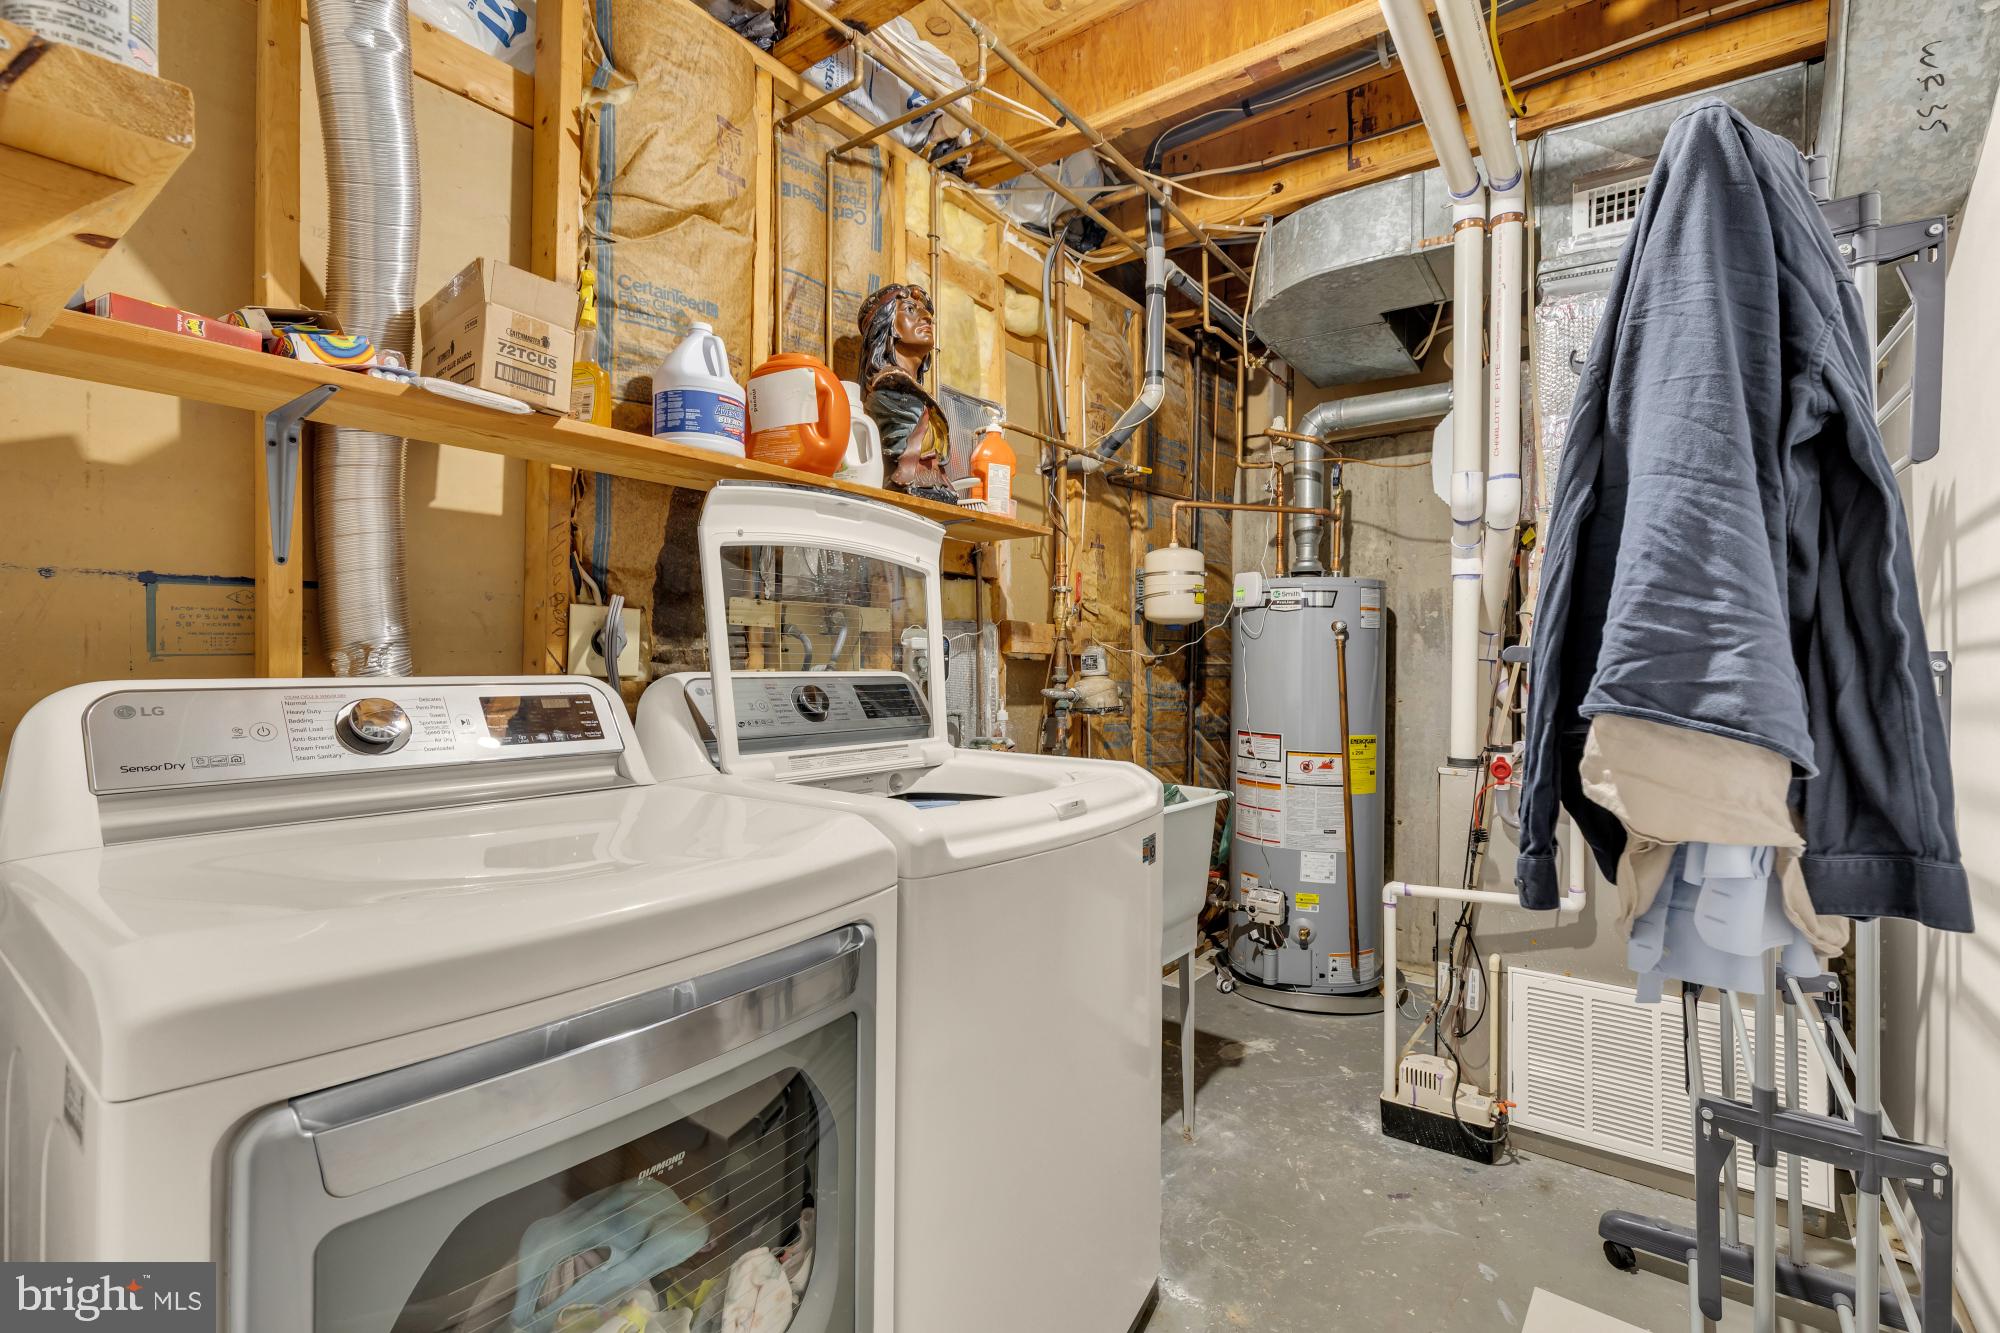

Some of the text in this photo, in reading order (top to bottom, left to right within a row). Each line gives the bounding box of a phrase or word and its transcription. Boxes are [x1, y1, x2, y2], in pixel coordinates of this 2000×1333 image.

[617, 274, 706, 313] CertainTeed
[498, 341, 557, 369] 72TCUS
[1493, 398, 1501, 457] CHARLOTTE
[140, 706, 165, 716] LG
[638, 1151, 686, 1180] DIAMOND
